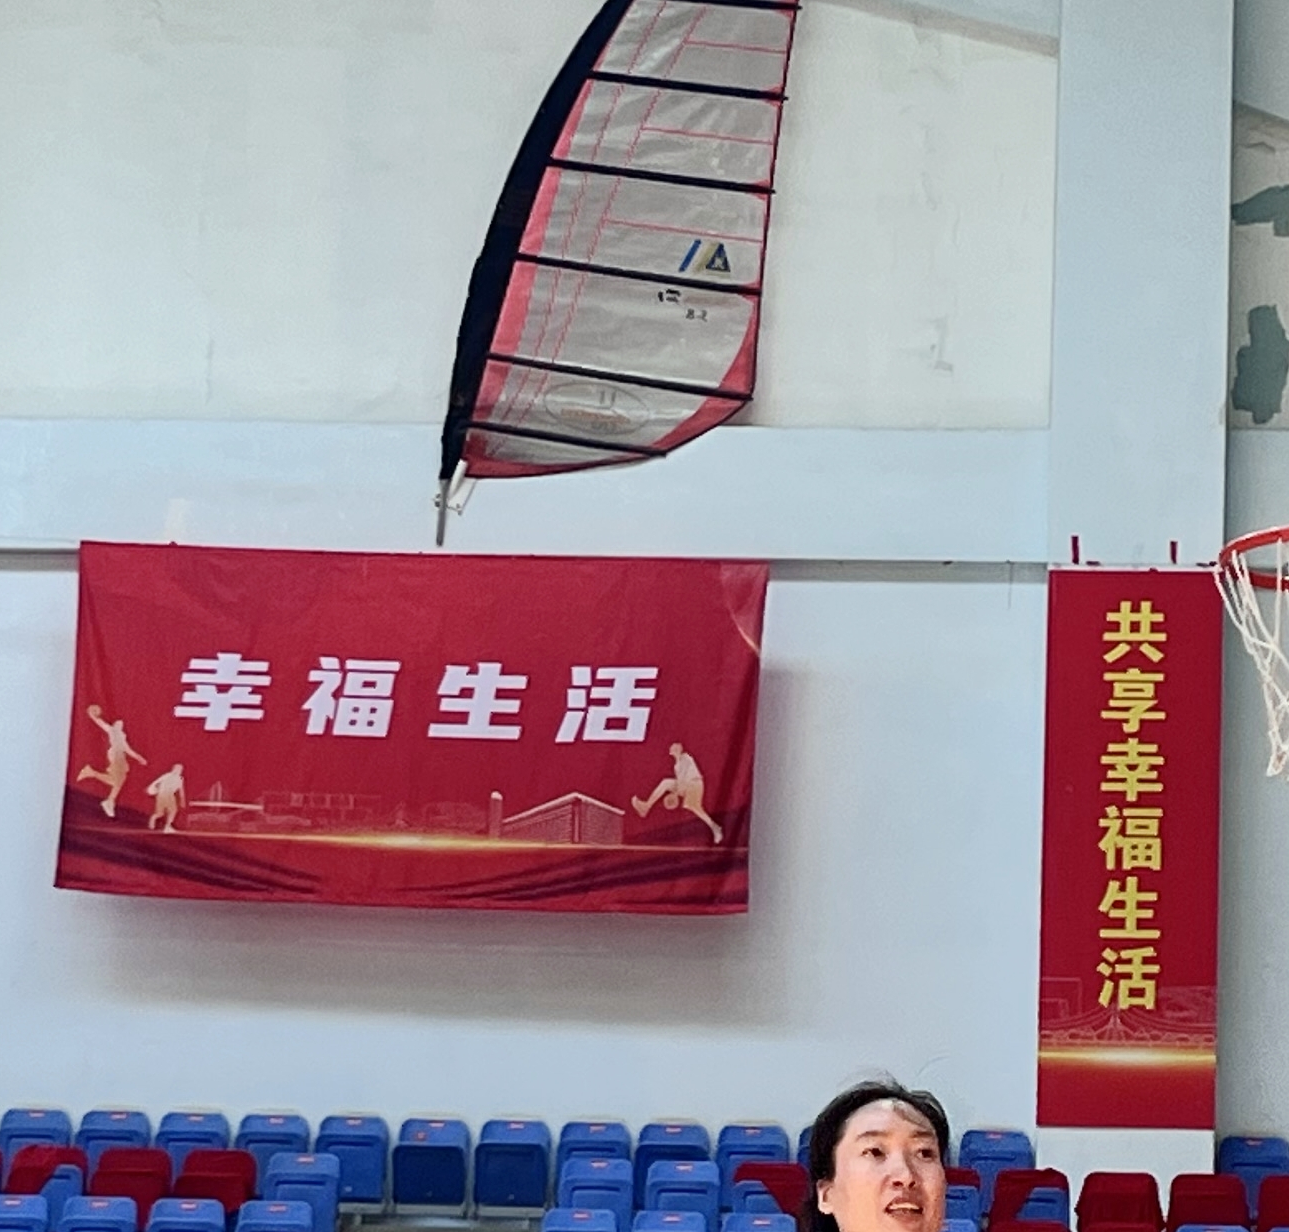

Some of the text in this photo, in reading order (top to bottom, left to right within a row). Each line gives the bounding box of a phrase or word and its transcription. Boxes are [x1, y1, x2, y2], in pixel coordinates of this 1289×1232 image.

[173, 652, 659, 743] 幸福生活
[1097, 601, 1167, 1010] 共享幸福生活
